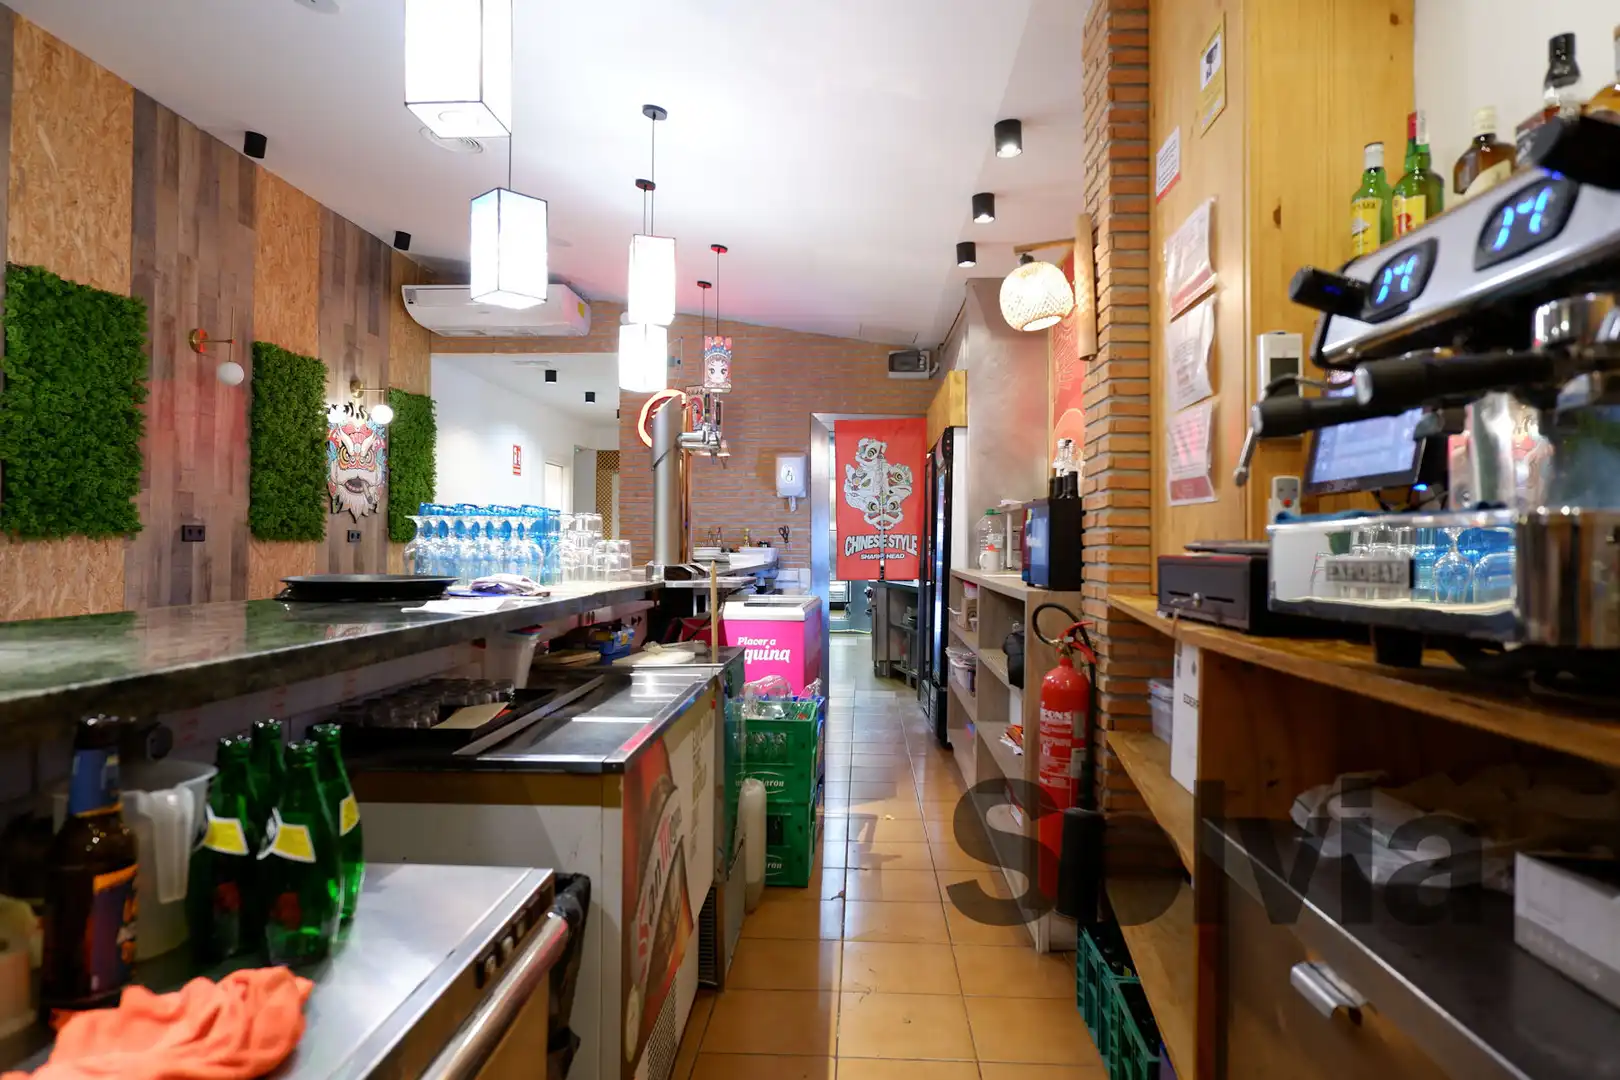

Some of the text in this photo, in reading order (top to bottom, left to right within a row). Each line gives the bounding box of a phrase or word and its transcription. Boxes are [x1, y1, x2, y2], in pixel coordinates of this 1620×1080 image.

[888, 534, 918, 556] STYLE
[737, 636, 777, 646] Placer a
[744, 645, 791, 664] quina
